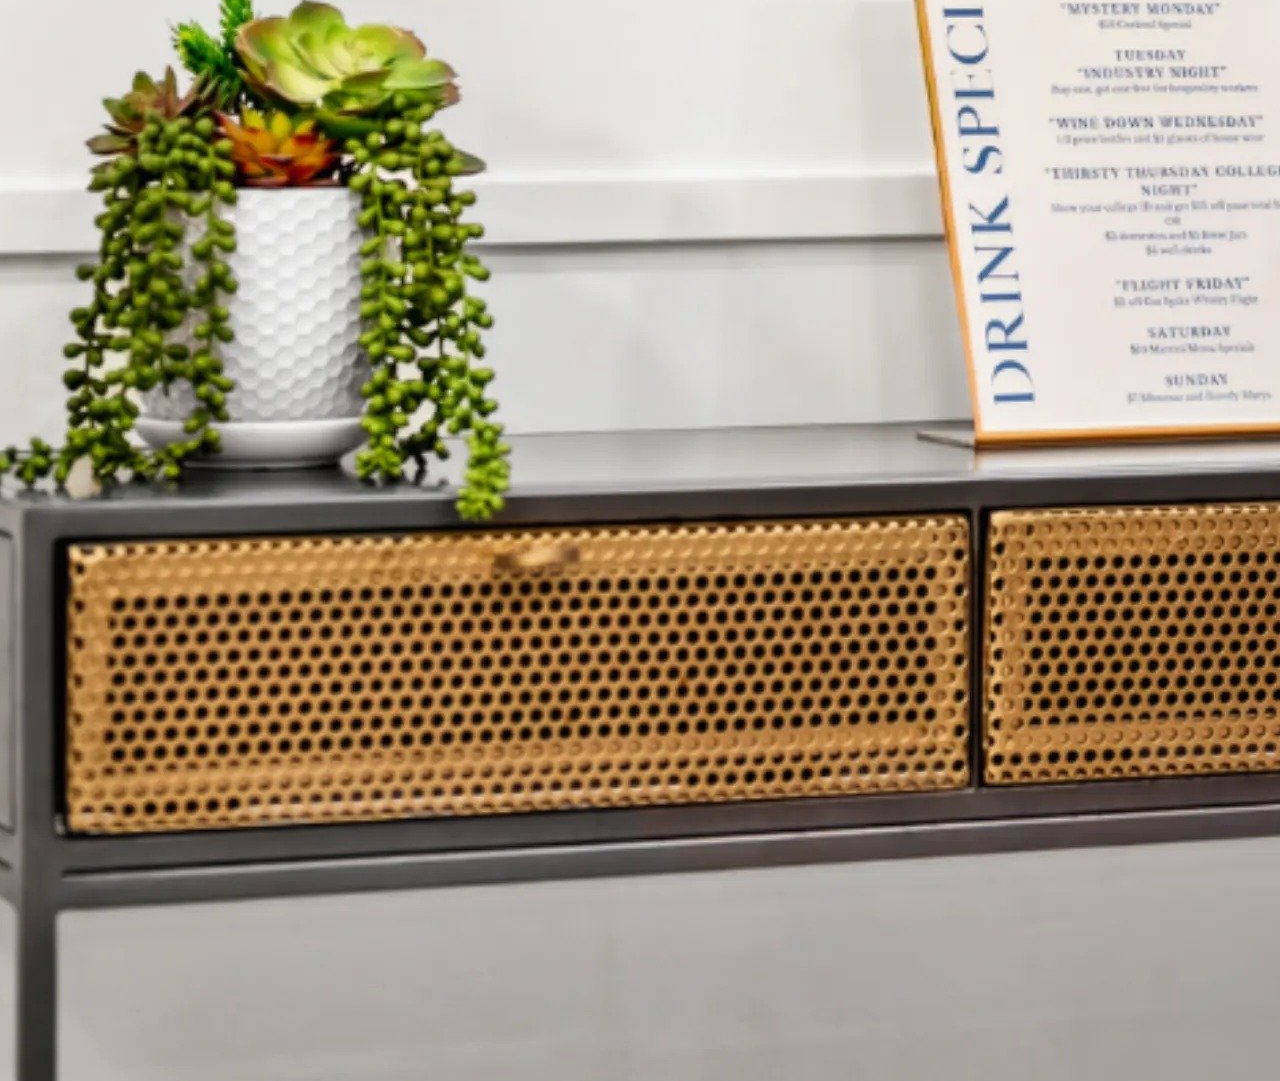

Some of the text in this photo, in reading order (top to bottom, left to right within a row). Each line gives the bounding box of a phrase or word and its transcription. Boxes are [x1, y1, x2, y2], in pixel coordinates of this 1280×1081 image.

[1146, 2, 1221, 16] MONDAY"
[1114, 49, 1187, 62] TUESDAY
[1169, 65, 1227, 79] NIGHT"
[1103, 116, 1154, 129] DOWN
[1158, 114, 1264, 128] WEDNESDAY"
[1127, 165, 1209, 179] THURSDAY
[1140, 184, 1198, 197] NIGHT"
[1185, 276, 1250, 290] FRIDAY"
[968, 196, 1035, 405] DRINK
[1146, 325, 1231, 339] SATURDAY
[1164, 373, 1228, 387] SUNDAY
